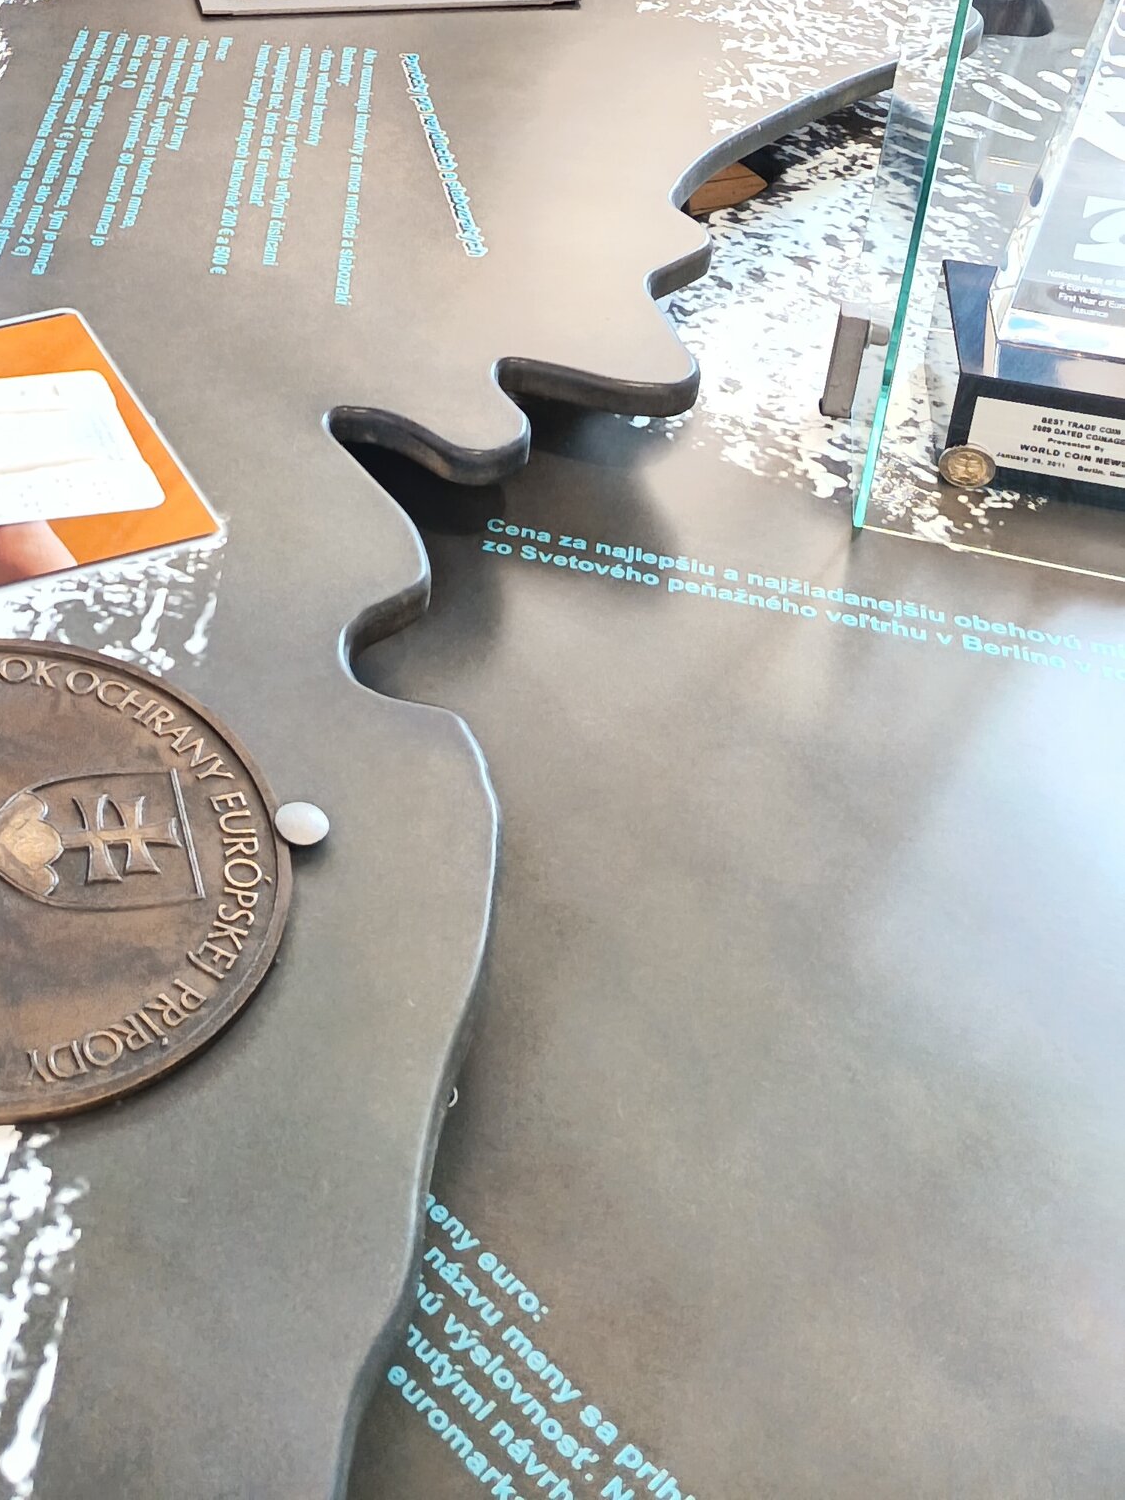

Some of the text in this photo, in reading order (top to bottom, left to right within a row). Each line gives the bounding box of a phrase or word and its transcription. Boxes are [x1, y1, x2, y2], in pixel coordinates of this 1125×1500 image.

[363, 49, 378, 65] Ako
[80, 128, 94, 139] je
[286, 124, 298, 137] sú
[352, 114, 368, 157] bankovky
[54, 139, 70, 148] je
[142, 146, 157, 156] je
[260, 136, 273, 148] sa
[68, 138, 92, 175] hodnota
[118, 152, 134, 166] 50
[352, 156, 362, 164] a
[20, 167, 35, 179] na
[131, 156, 155, 197] hodnota
[347, 164, 362, 193] mince
[53, 177, 78, 208] mince,
[105, 166, 127, 204] centová
[225, 159, 246, 208] bankoviek
[34, 185, 52, 203] ako
[21, 205, 43, 236] minca
[48, 210, 68, 229] tým
[95, 204, 115, 235] minca
[120, 196, 141, 229] mince,
[221, 208, 238, 228] 200
[15, 236, 35, 245] 2
[42, 229, 59, 241] je
[91, 235, 106, 248] je
[217, 237, 228, 245] a
[342, 240, 352, 248] a
[29, 242, 54, 277] minca
[212, 246, 230, 266] 500
[210, 266, 226, 274] €
[1041, 417, 1065, 426] BEST
[1068, 421, 1096, 432] TRADE
[1054, 428, 1083, 439] DATED
[996, 451, 1028, 463] January
[1020, 443, 1060, 457] WORLD
[1065, 452, 1092, 462] COIN
[488, 518, 1081, 650] Cena za najlepšiu a najžiadanejšiu obehovú
[483, 541, 1066, 669] zo Svetového peňažného veľtrhu v Berlíne
[66, 669, 235, 782] OCHRANY
[189, 787, 275, 980] EURÓPSKEJ
[25, 977, 207, 1085] PRÍRODY
[478, 1251, 549, 1323] euro:
[424, 1246, 504, 1326] názvu
[501, 1325, 582, 1404] meny
[579, 1404, 619, 1446] sa
[443, 1313, 600, 1482] výslovnosť.
[387, 1365, 526, 1500] euromark
